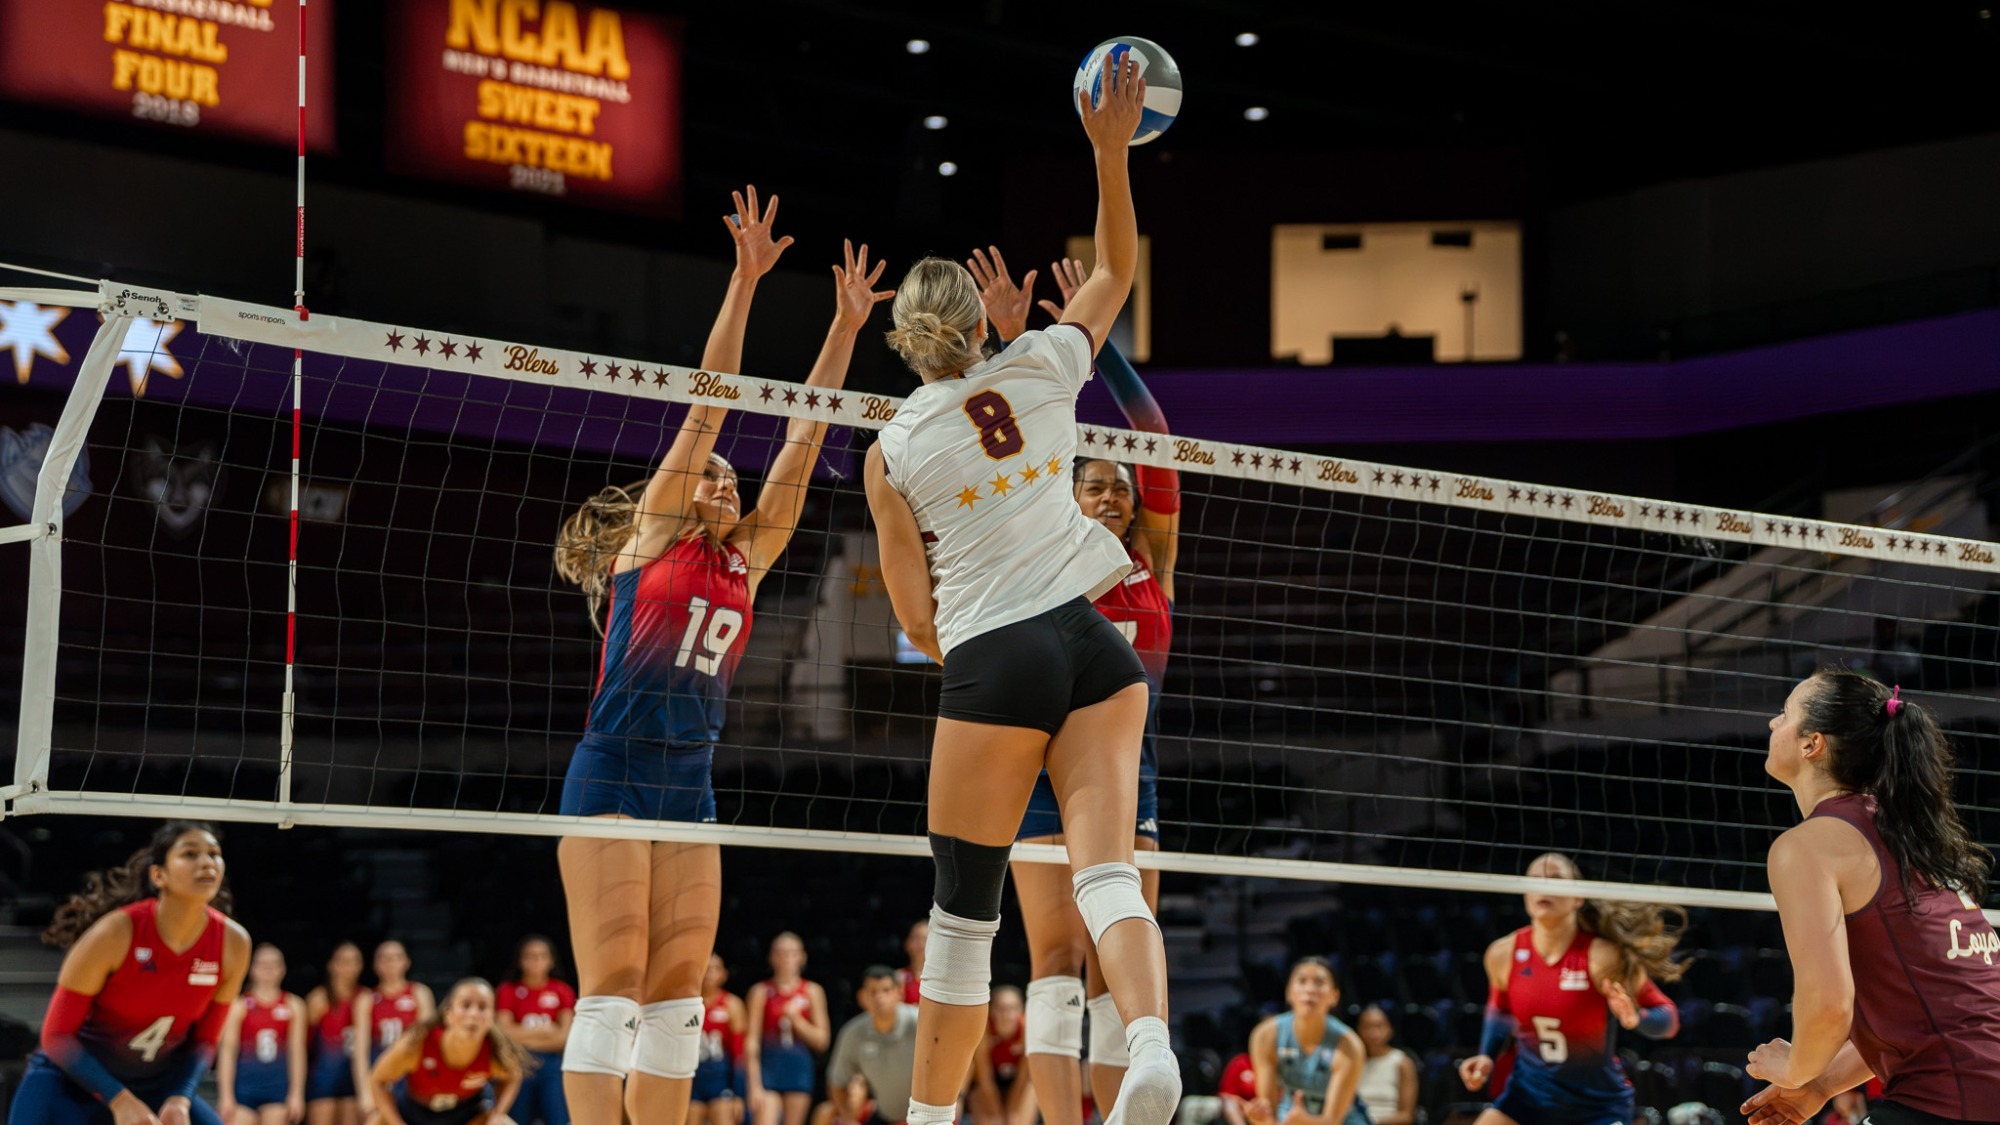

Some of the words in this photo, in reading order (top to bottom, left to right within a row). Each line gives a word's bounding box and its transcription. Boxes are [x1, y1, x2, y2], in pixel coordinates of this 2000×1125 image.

[103, 2, 228, 64] FINAL
[446, 0, 630, 80] NCAA
[112, 48, 220, 108] FOUR
[477, 79, 600, 135] SWEET
[464, 120, 612, 181] SIXTEEN
[131, 292, 161, 303] Senoh
[860, 397, 897, 421] 'Ble
[962, 388, 1025, 461] 8
[674, 596, 744, 677] 19
[1947, 919, 2000, 965] Loyo
[128, 1016, 176, 1062] 4
[1532, 1016, 1568, 1063] 5
